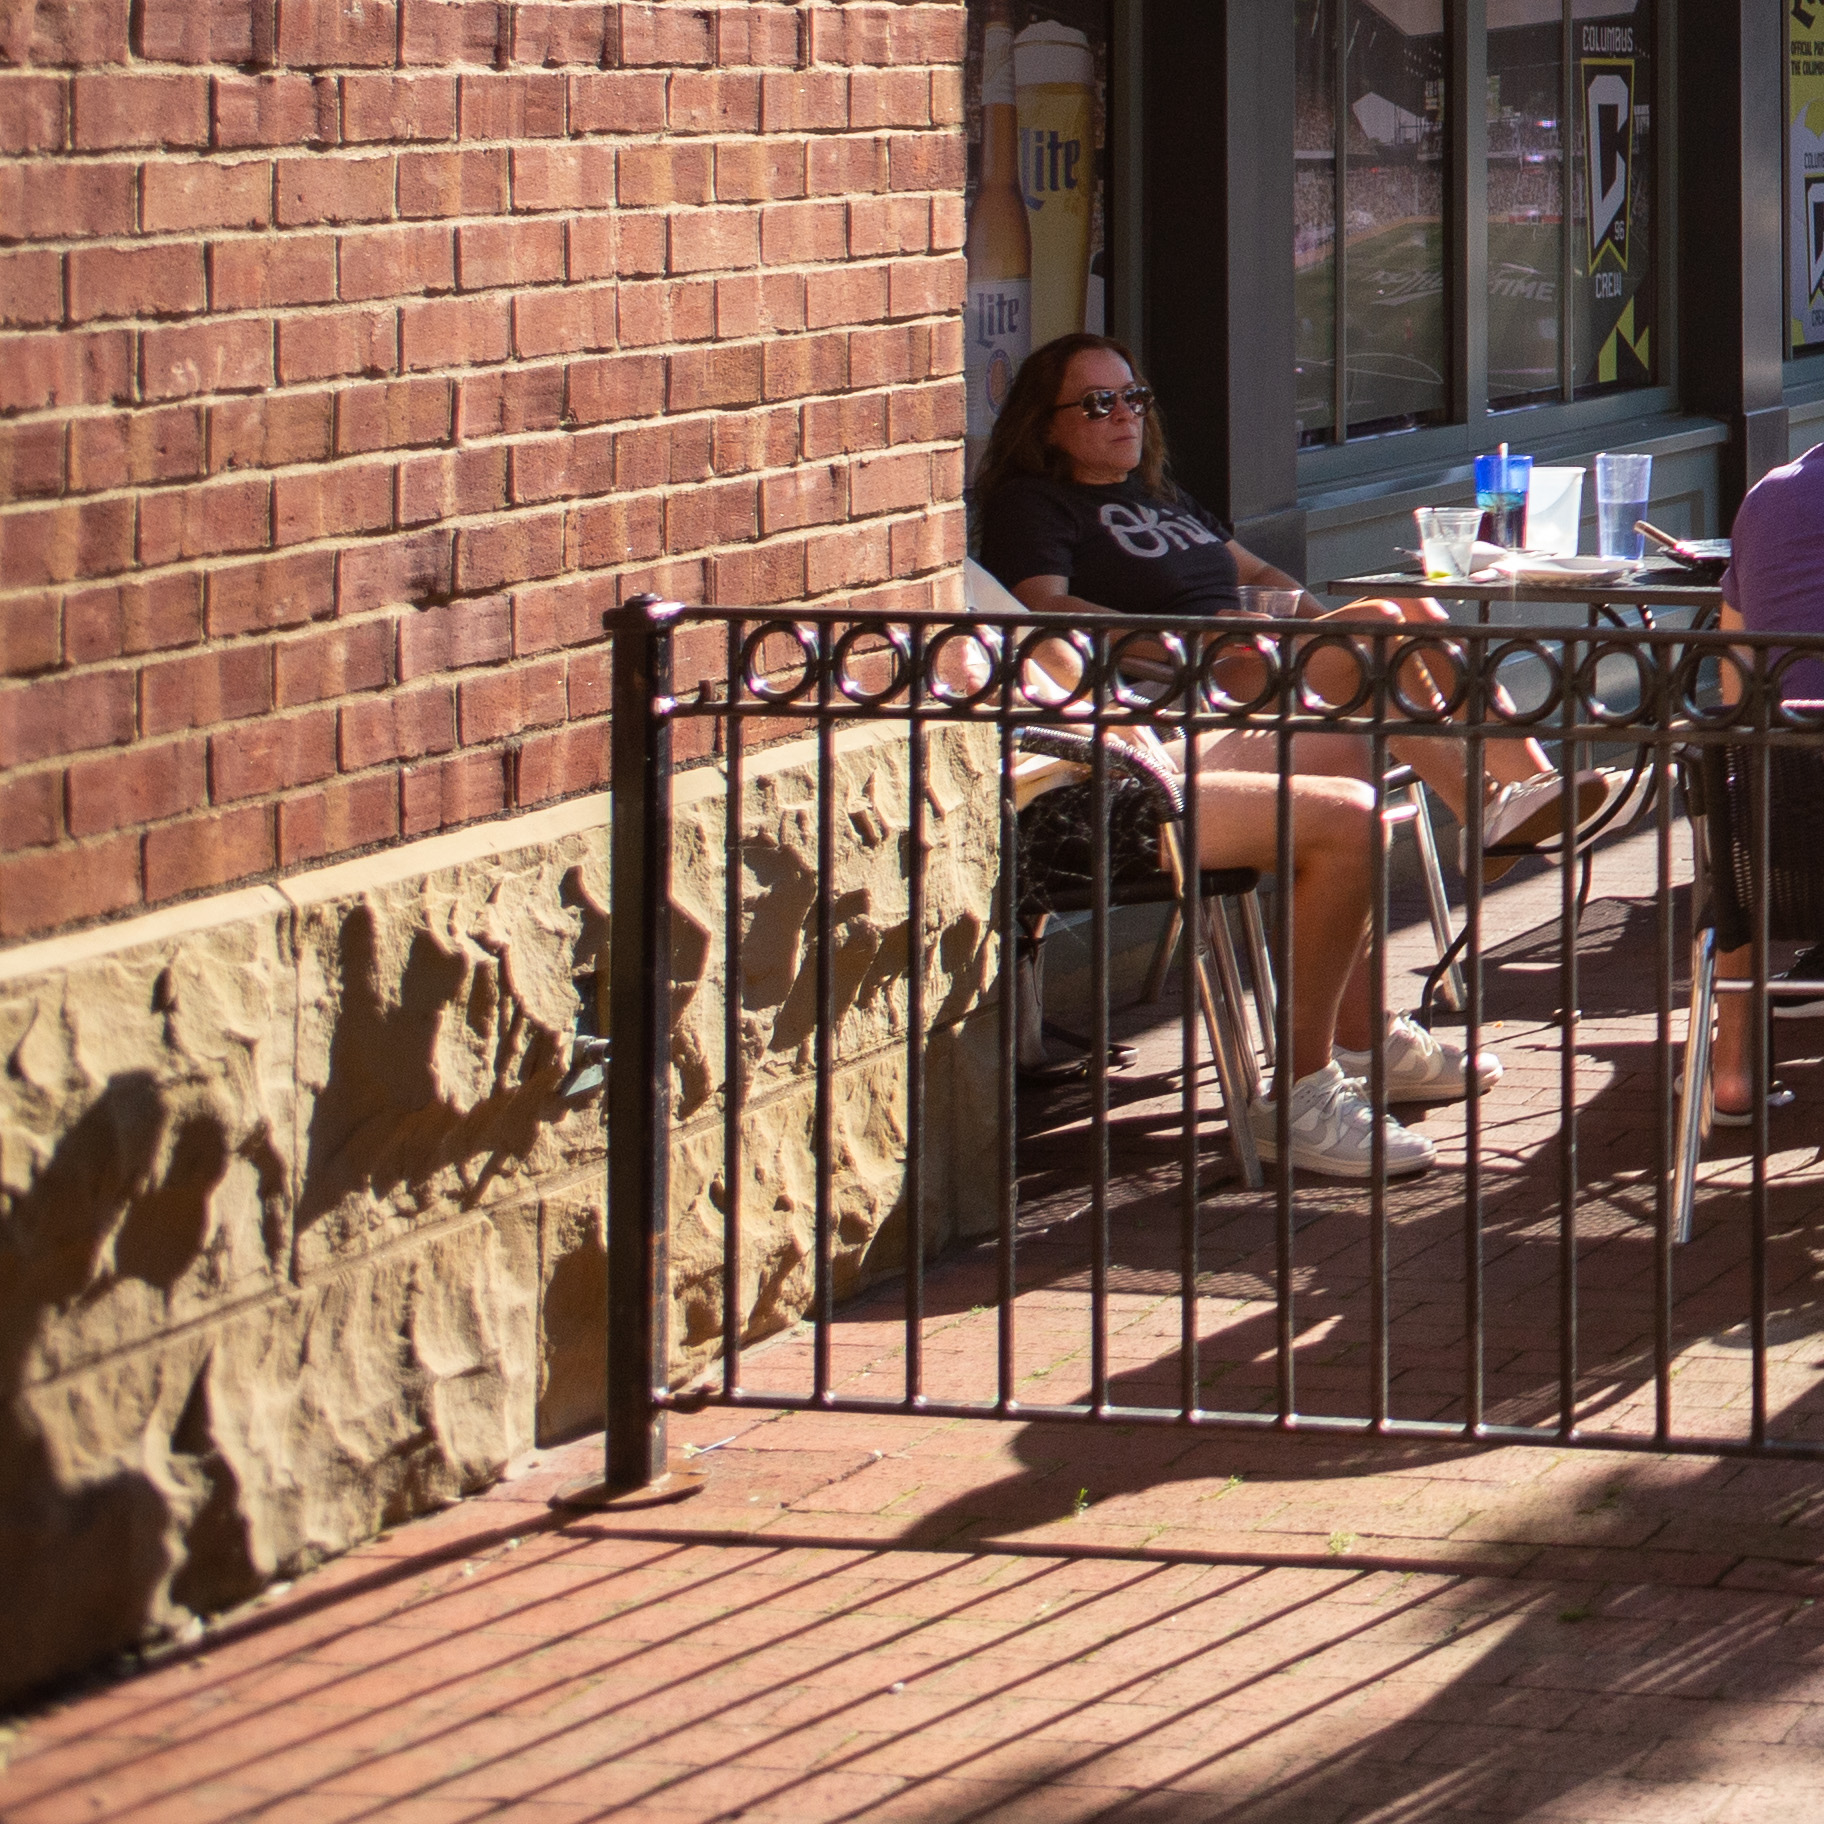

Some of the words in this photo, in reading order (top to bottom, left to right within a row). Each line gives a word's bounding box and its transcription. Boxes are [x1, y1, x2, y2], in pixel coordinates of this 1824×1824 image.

[1582, 26, 1634, 52] COLUMBUS
[1019, 127, 1081, 212] Lite
[1614, 221, 1625, 240] 96
[1595, 272, 1623, 299] CREW
[975, 292, 1019, 350] Lite
